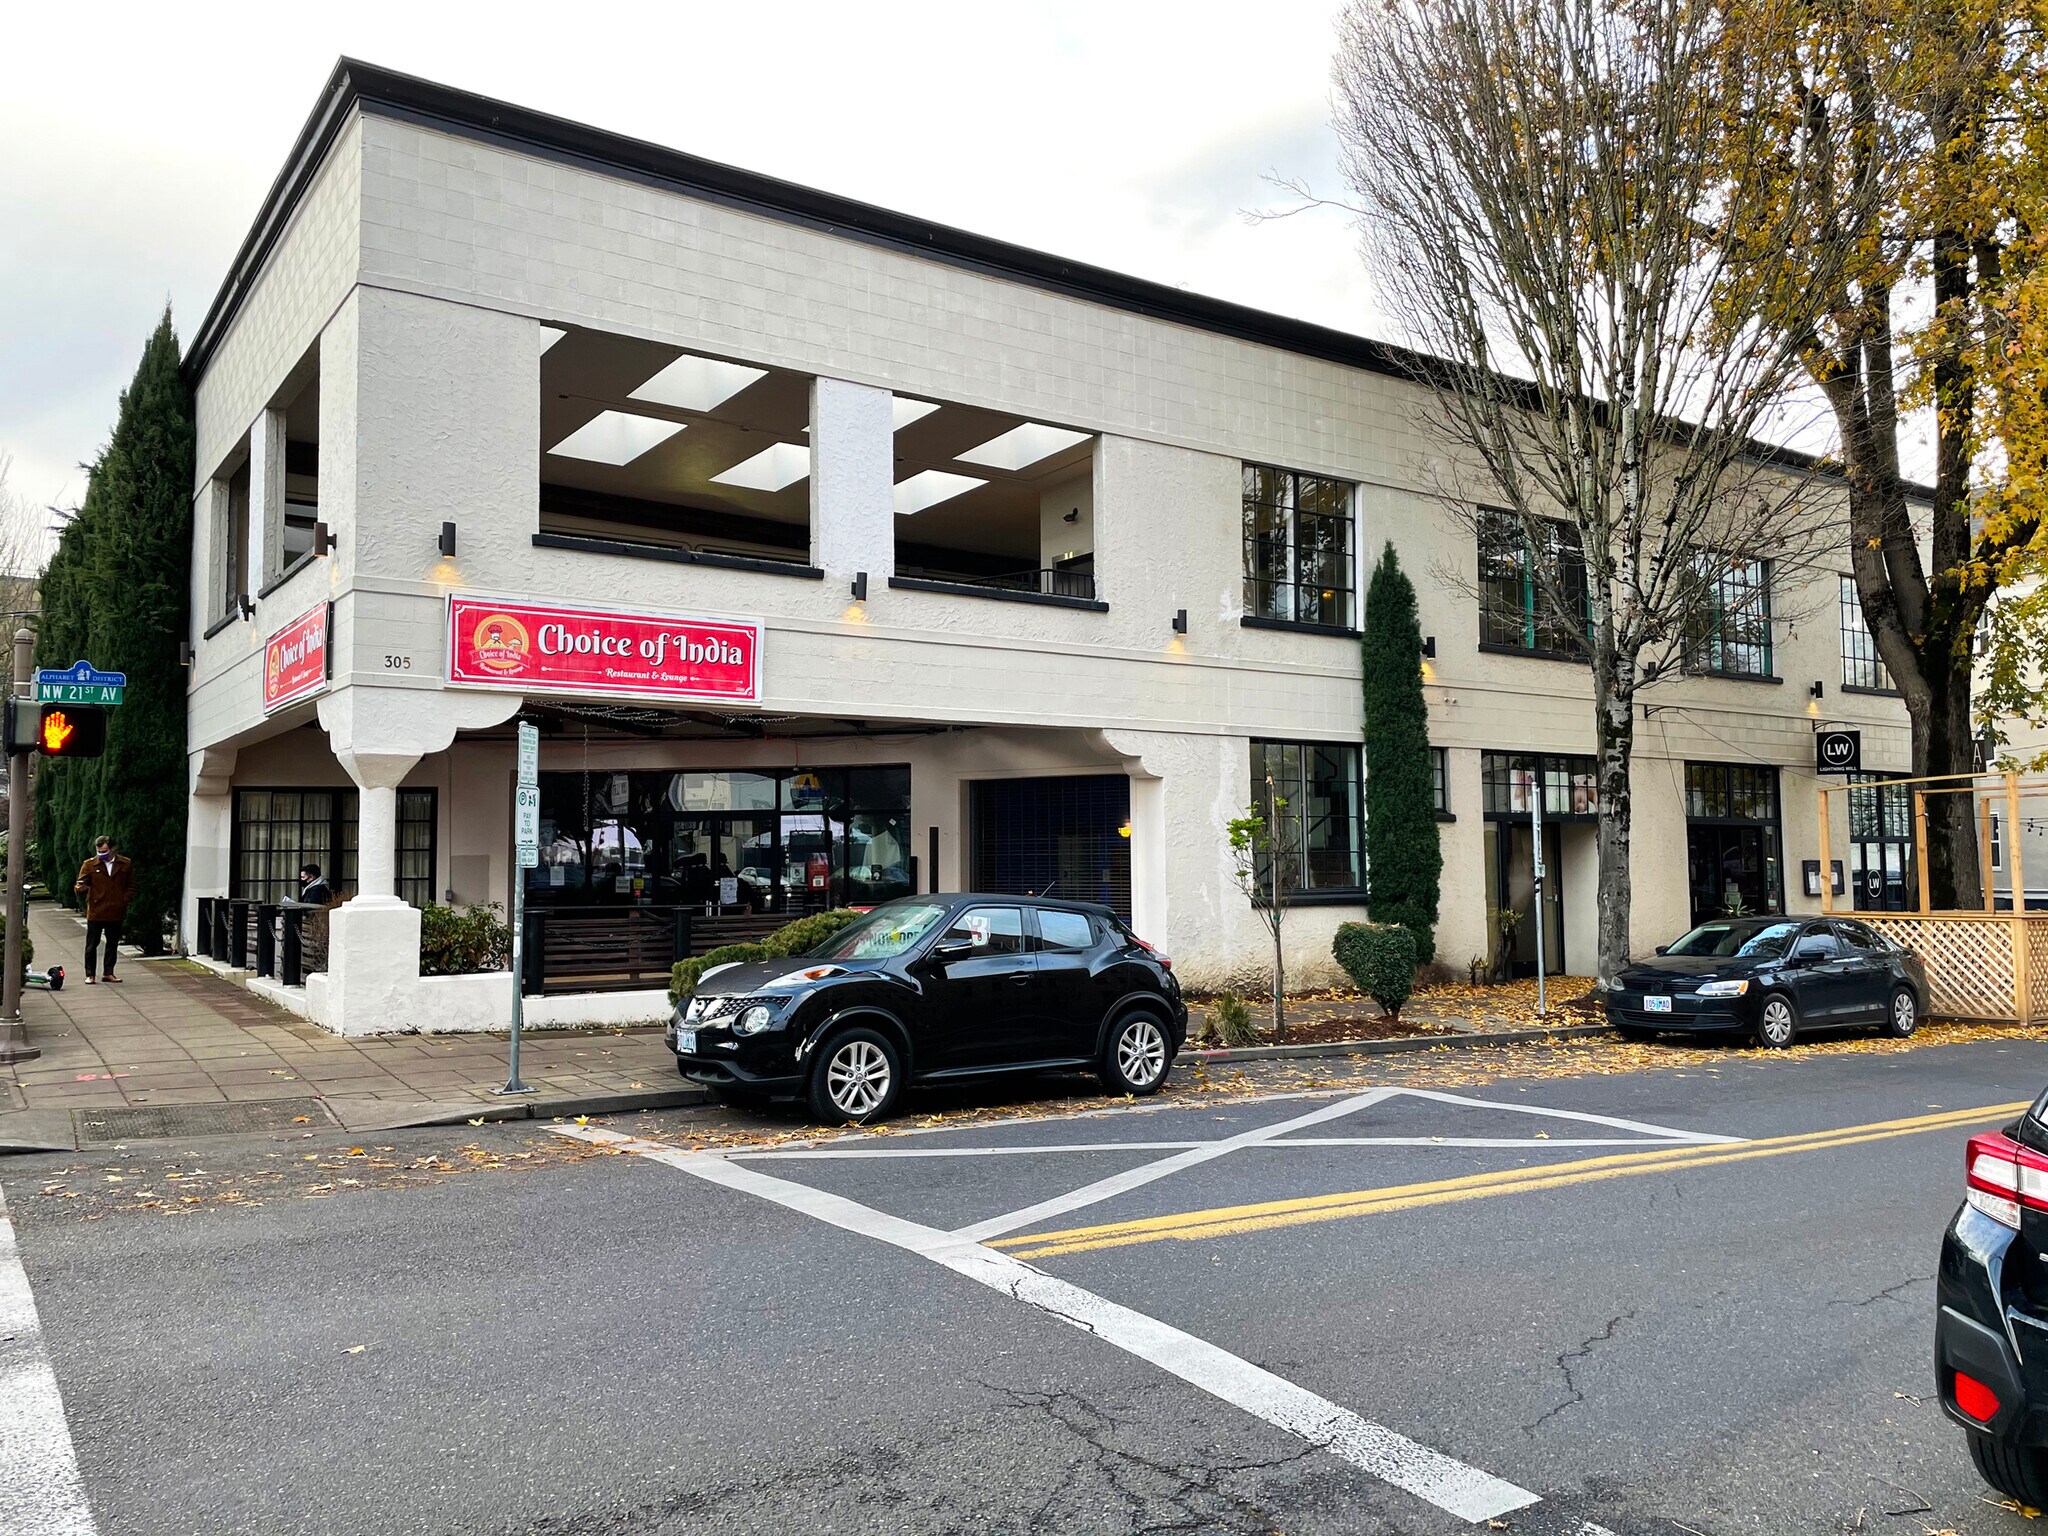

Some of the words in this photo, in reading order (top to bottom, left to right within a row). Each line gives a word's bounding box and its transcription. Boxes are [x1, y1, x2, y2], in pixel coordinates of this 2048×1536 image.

[280, 642, 299, 673] Choice
[298, 629, 307, 665] of
[306, 624, 323, 655] India
[538, 624, 633, 657] Choice
[639, 632, 671, 666] of
[673, 635, 743, 665] India
[384, 655, 411, 669] 305
[480, 650, 498, 659] Choice
[499, 650, 505, 659] of
[506, 650, 521, 660] India
[605, 668, 650, 680] Restaurant
[651, 671, 660, 680] &
[660, 672, 688, 682] Lounge
[42, 685, 63, 699] NW
[69, 686, 94, 700] 21ST
[101, 687, 116, 701] AV
[1827, 743, 1849, 755] LW
[521, 827, 533, 835] PARK
[1869, 878, 1880, 889] LW
